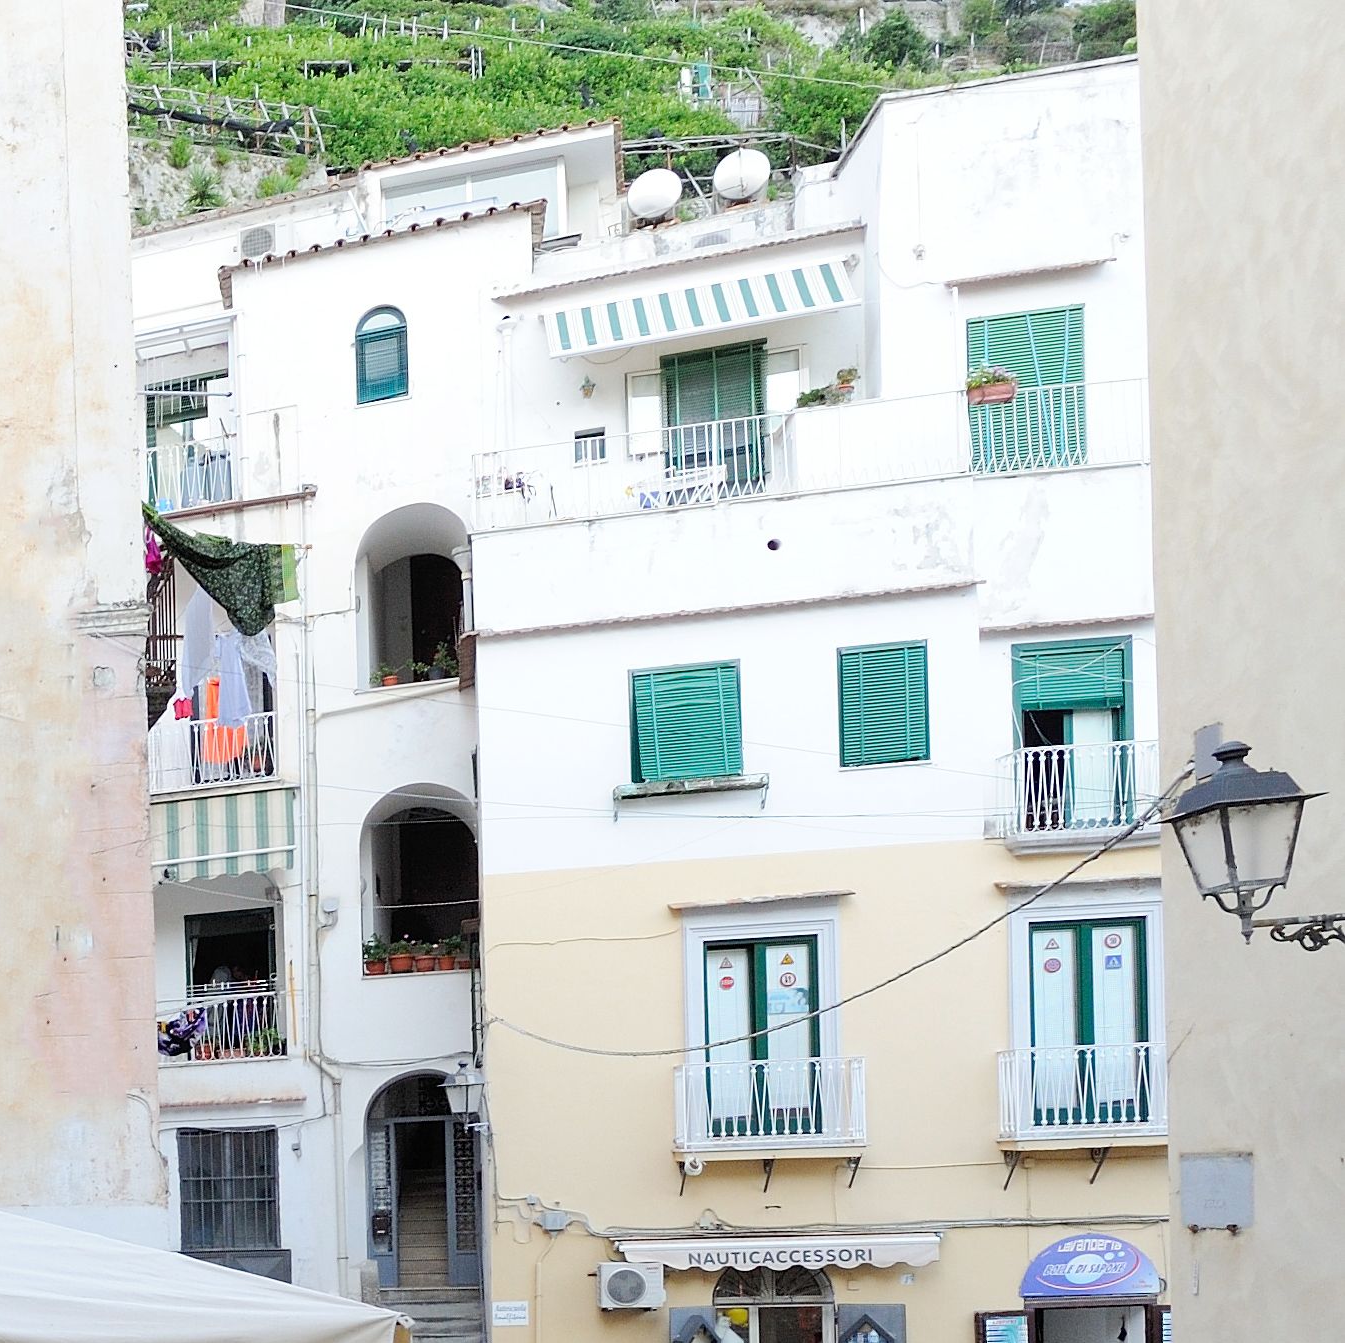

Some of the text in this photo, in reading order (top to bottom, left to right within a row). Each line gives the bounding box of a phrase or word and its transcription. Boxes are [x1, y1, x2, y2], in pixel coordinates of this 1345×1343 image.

[688, 1248, 873, 1266] NAUTICACCESSORI
[1075, 1263, 1087, 1275] DI
[1088, 1261, 1127, 1275] SAPONE
